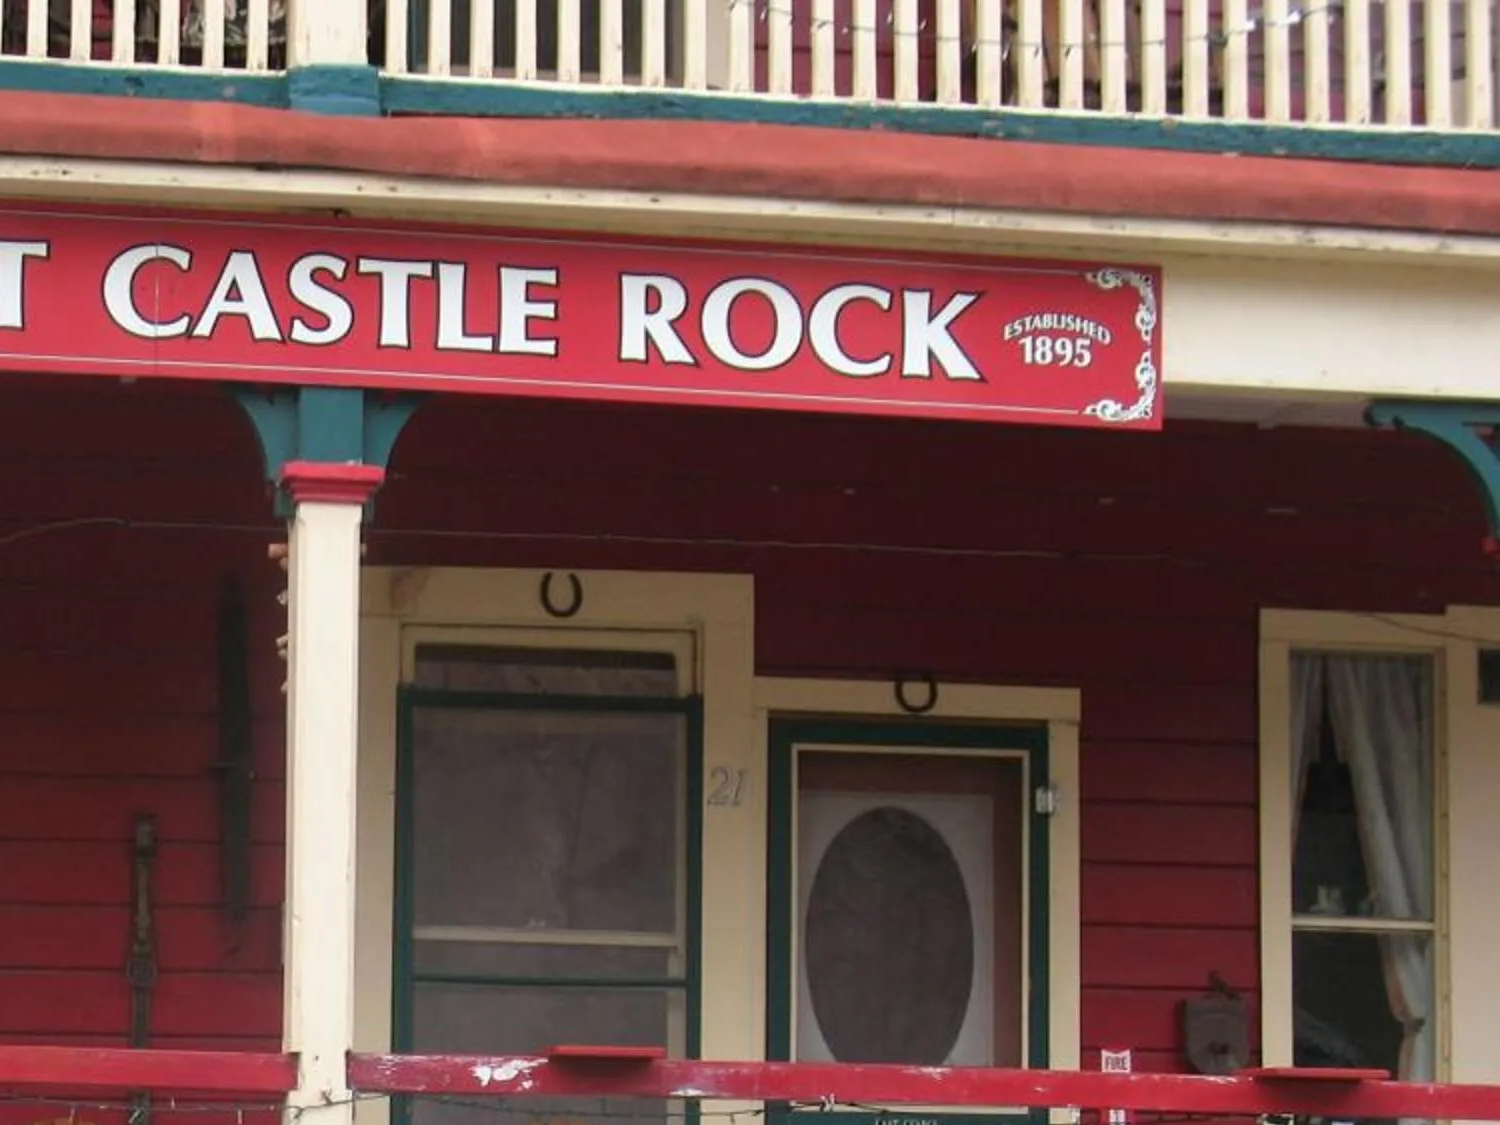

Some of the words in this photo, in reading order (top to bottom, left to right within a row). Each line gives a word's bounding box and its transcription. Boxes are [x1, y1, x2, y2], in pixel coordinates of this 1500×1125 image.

[102, 242, 560, 359] CASTLE
[616, 271, 988, 383] ROCK
[1003, 310, 1111, 346] ESTABLISHED
[1018, 334, 1093, 369] 1895
[706, 765, 750, 808] 21
[1104, 1055, 1129, 1071] FIRE
